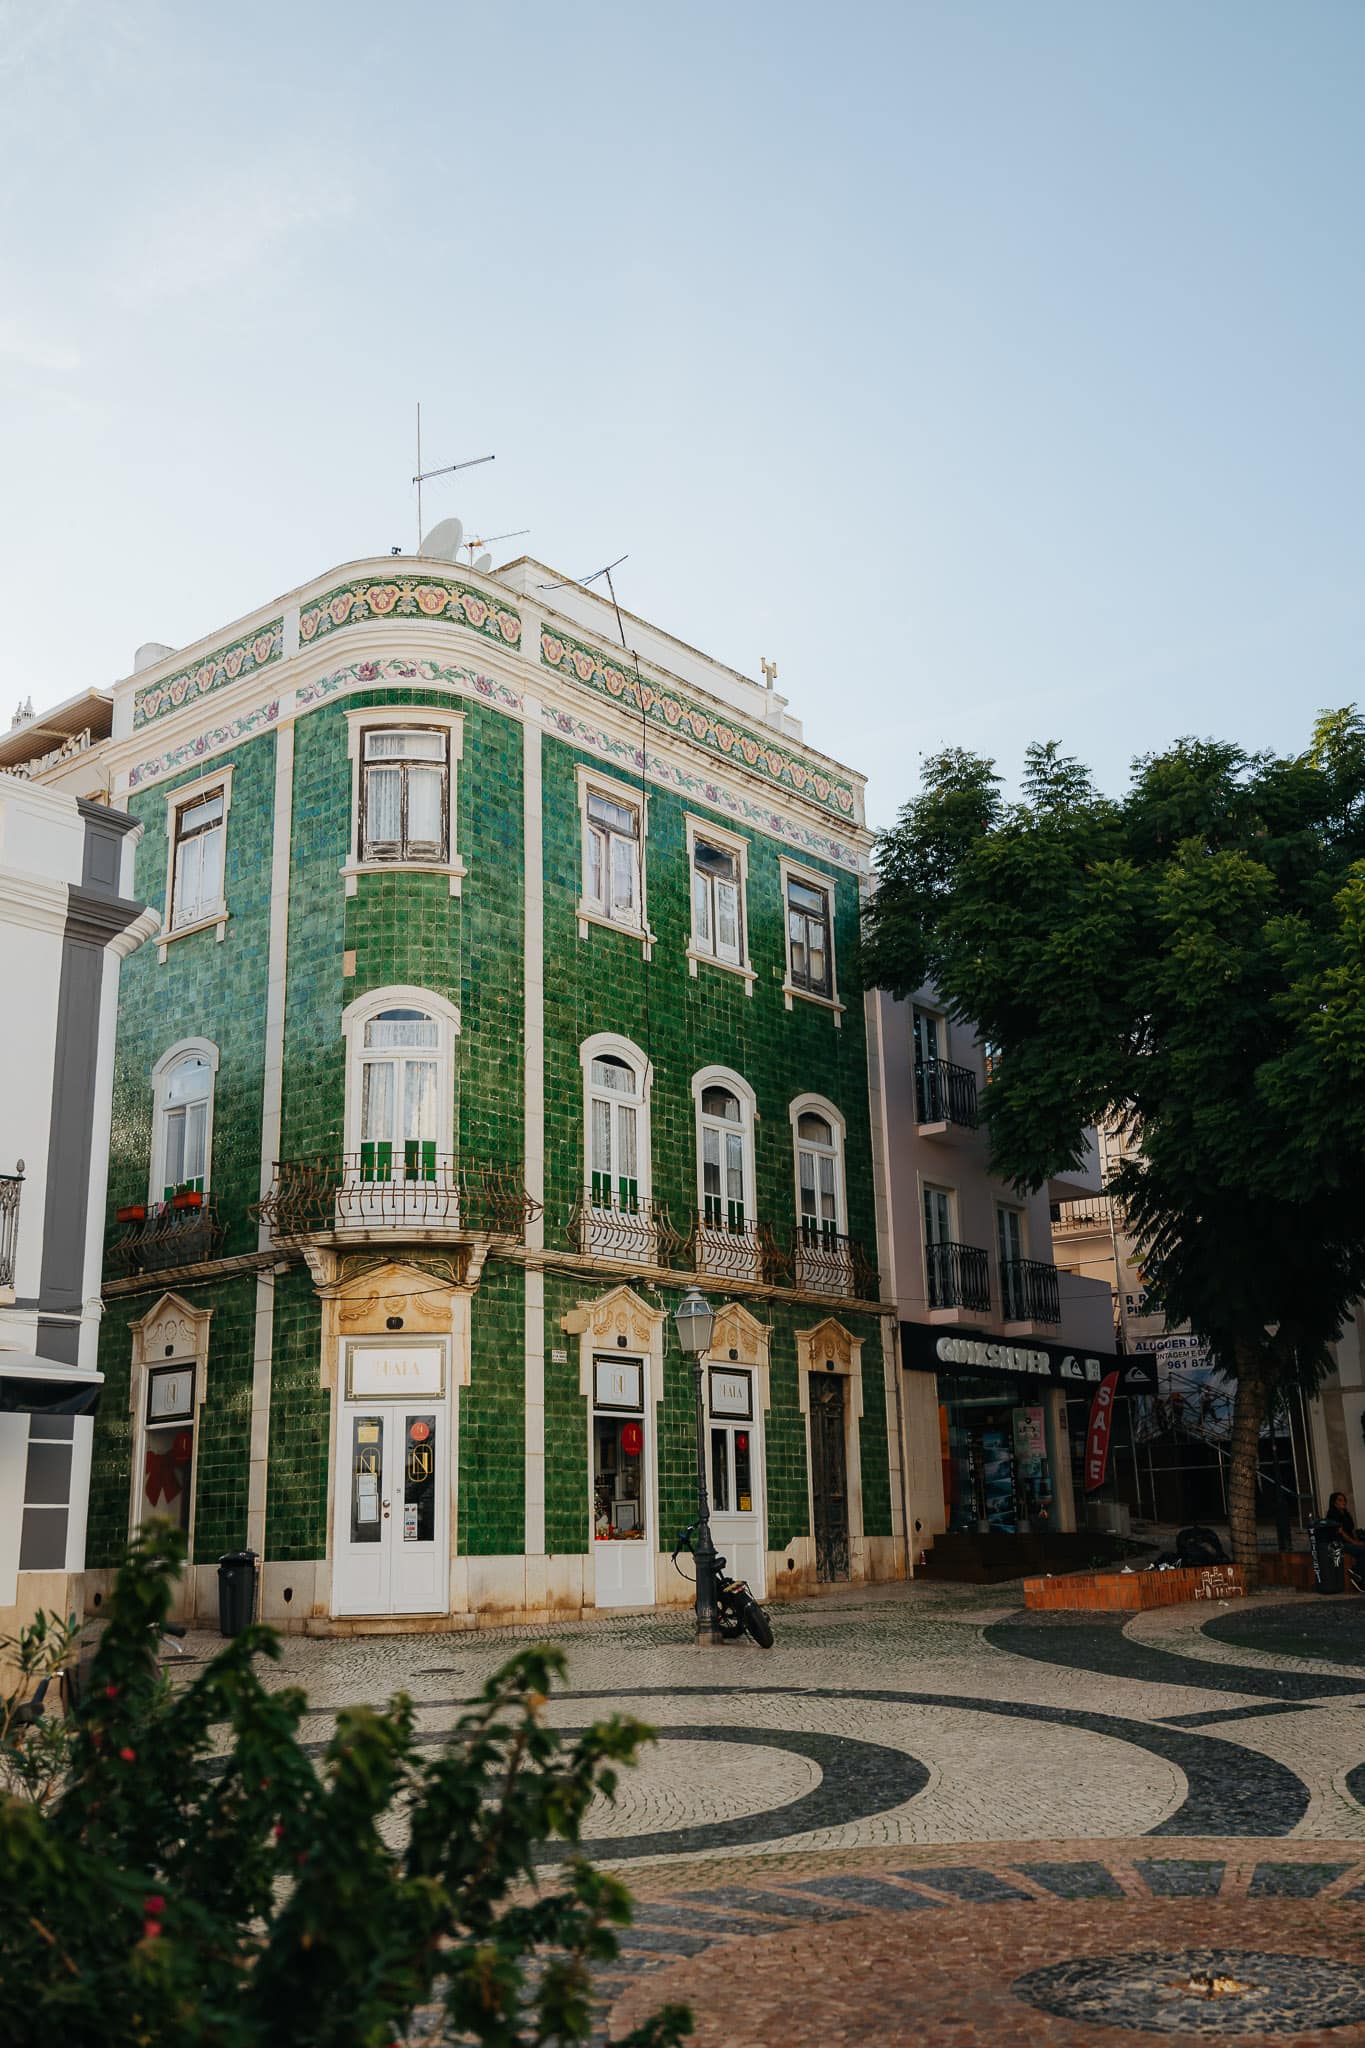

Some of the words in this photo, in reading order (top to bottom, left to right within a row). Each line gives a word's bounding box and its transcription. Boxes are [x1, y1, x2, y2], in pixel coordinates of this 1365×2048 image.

[936, 1337, 1051, 1375] QUIKSILVER
[1135, 1339, 1186, 1351] ALUGUER
[1167, 1360, 1187, 1369] 961
[1090, 1386, 1111, 1479] SALE
